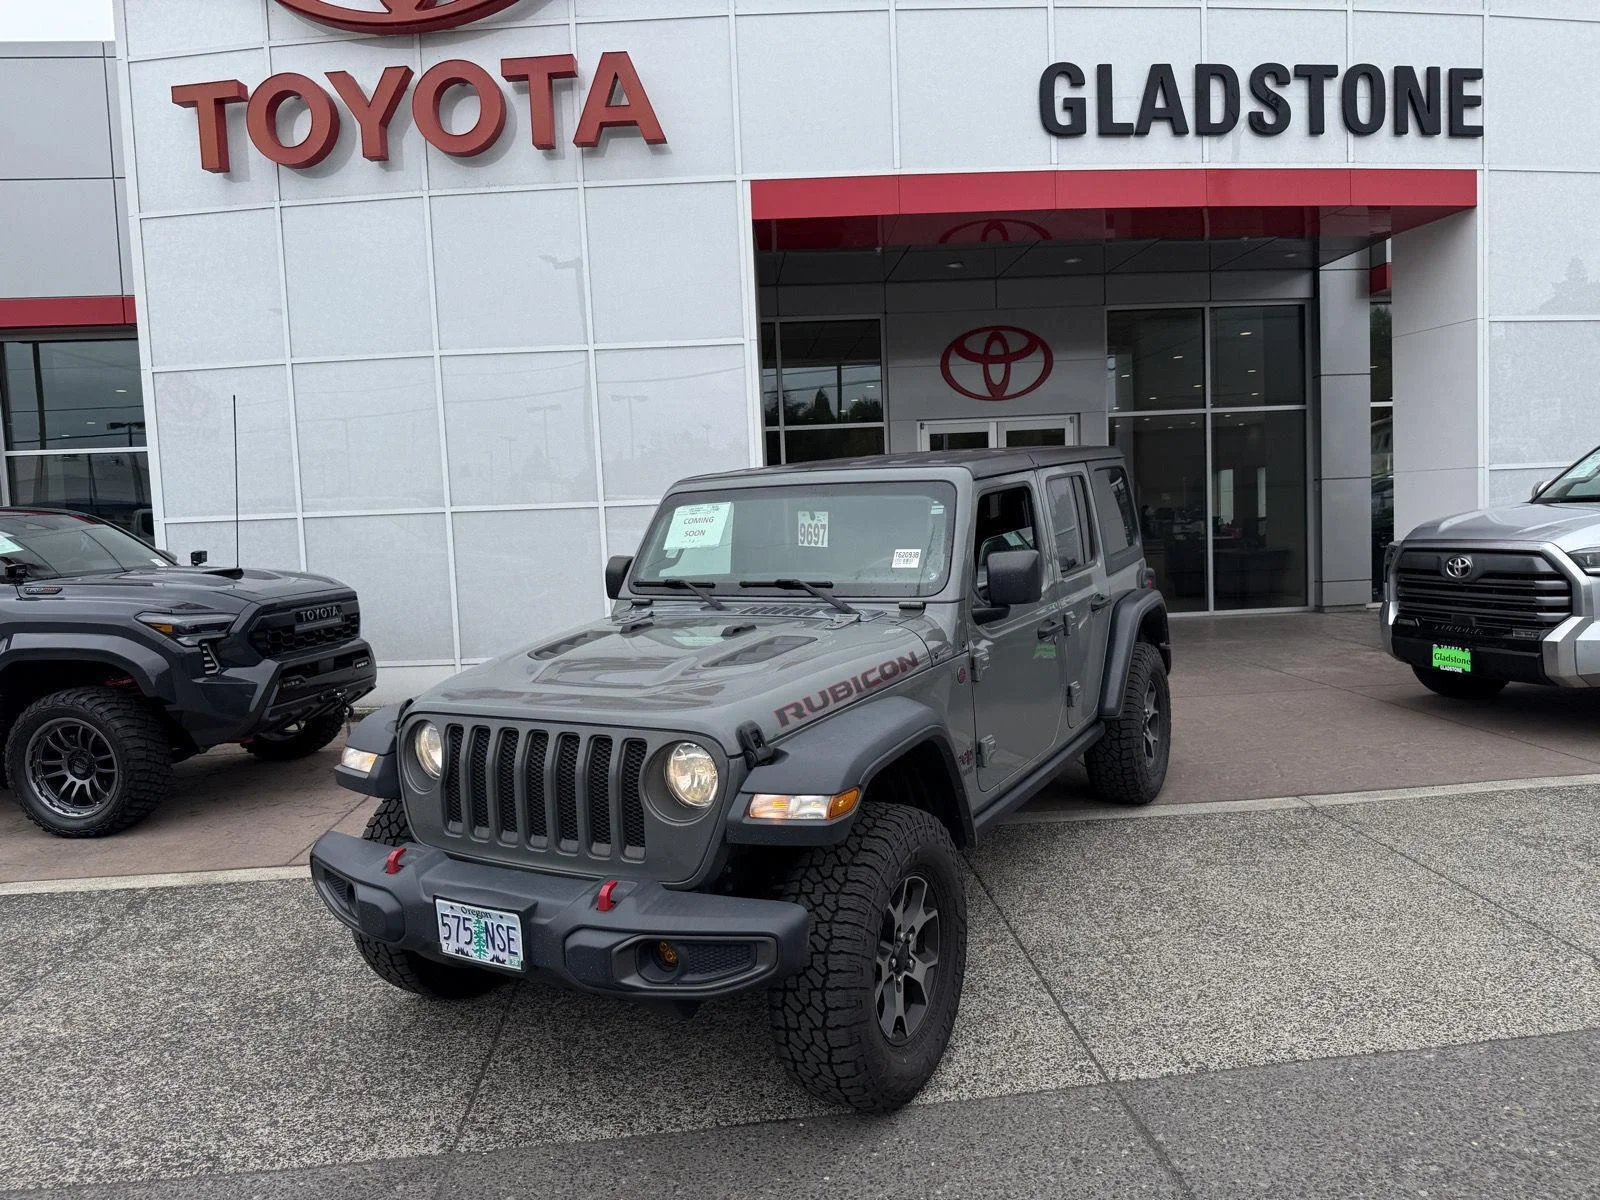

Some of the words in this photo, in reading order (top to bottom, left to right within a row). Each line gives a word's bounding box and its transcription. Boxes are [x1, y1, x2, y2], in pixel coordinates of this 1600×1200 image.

[1038, 61, 1484, 137] GLADSTONE
[171, 51, 668, 173] TOYOTA
[683, 516, 715, 525] COMING
[683, 529, 706, 537] SOON
[799, 523, 827, 546] 9697
[300, 606, 339, 622] TOYOTA
[1434, 652, 1471, 666] Gladstone
[773, 651, 920, 728] RUBICON
[461, 906, 493, 919] Oregon
[440, 912, 474, 945] 575
[484, 920, 518, 956] NSE
